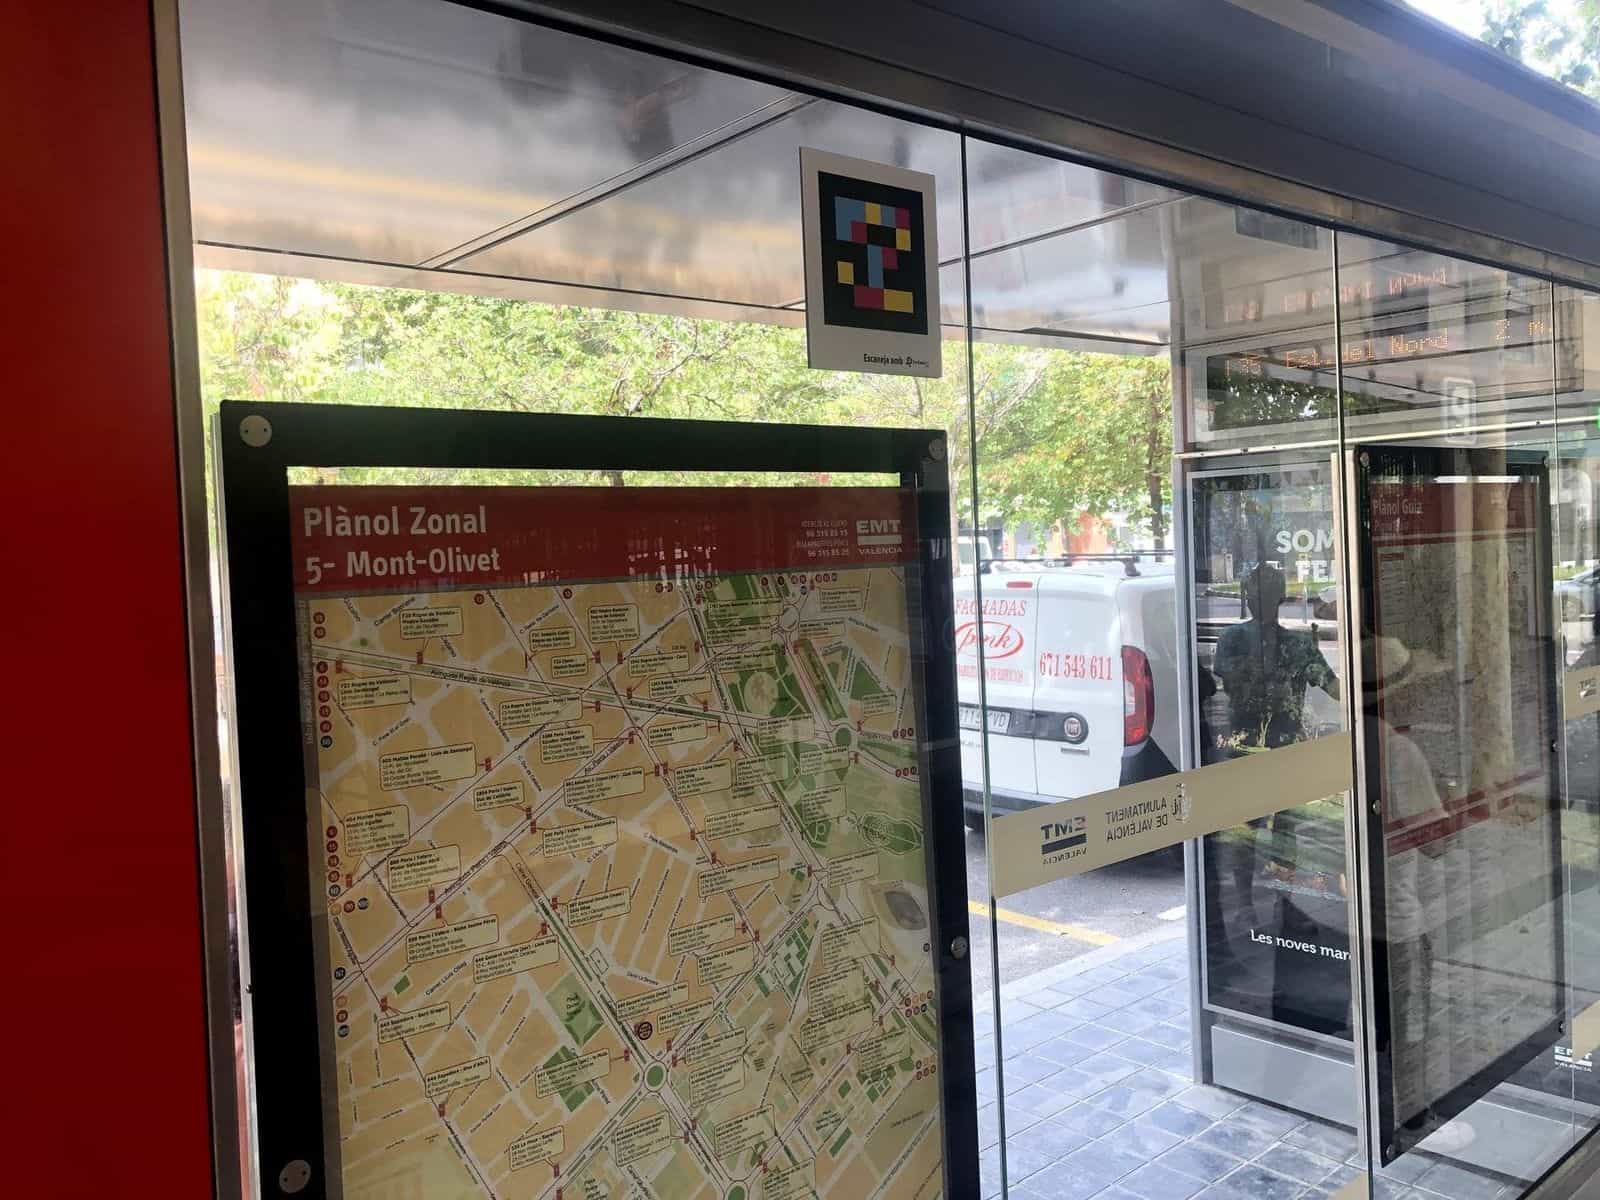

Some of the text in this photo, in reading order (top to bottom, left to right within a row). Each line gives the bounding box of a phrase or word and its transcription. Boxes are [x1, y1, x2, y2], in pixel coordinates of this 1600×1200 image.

[864, 353, 889, 367] Escaneja
[303, 504, 487, 537] Plànol Zonal
[855, 519, 901, 534] EMT
[305, 546, 501, 585] 5- Mont-Olivet
[1039, 652, 1060, 677] 671
[1063, 653, 1086, 679] 543
[1090, 655, 1113, 681] 611
[1249, 929, 1352, 961] Les noves mar
